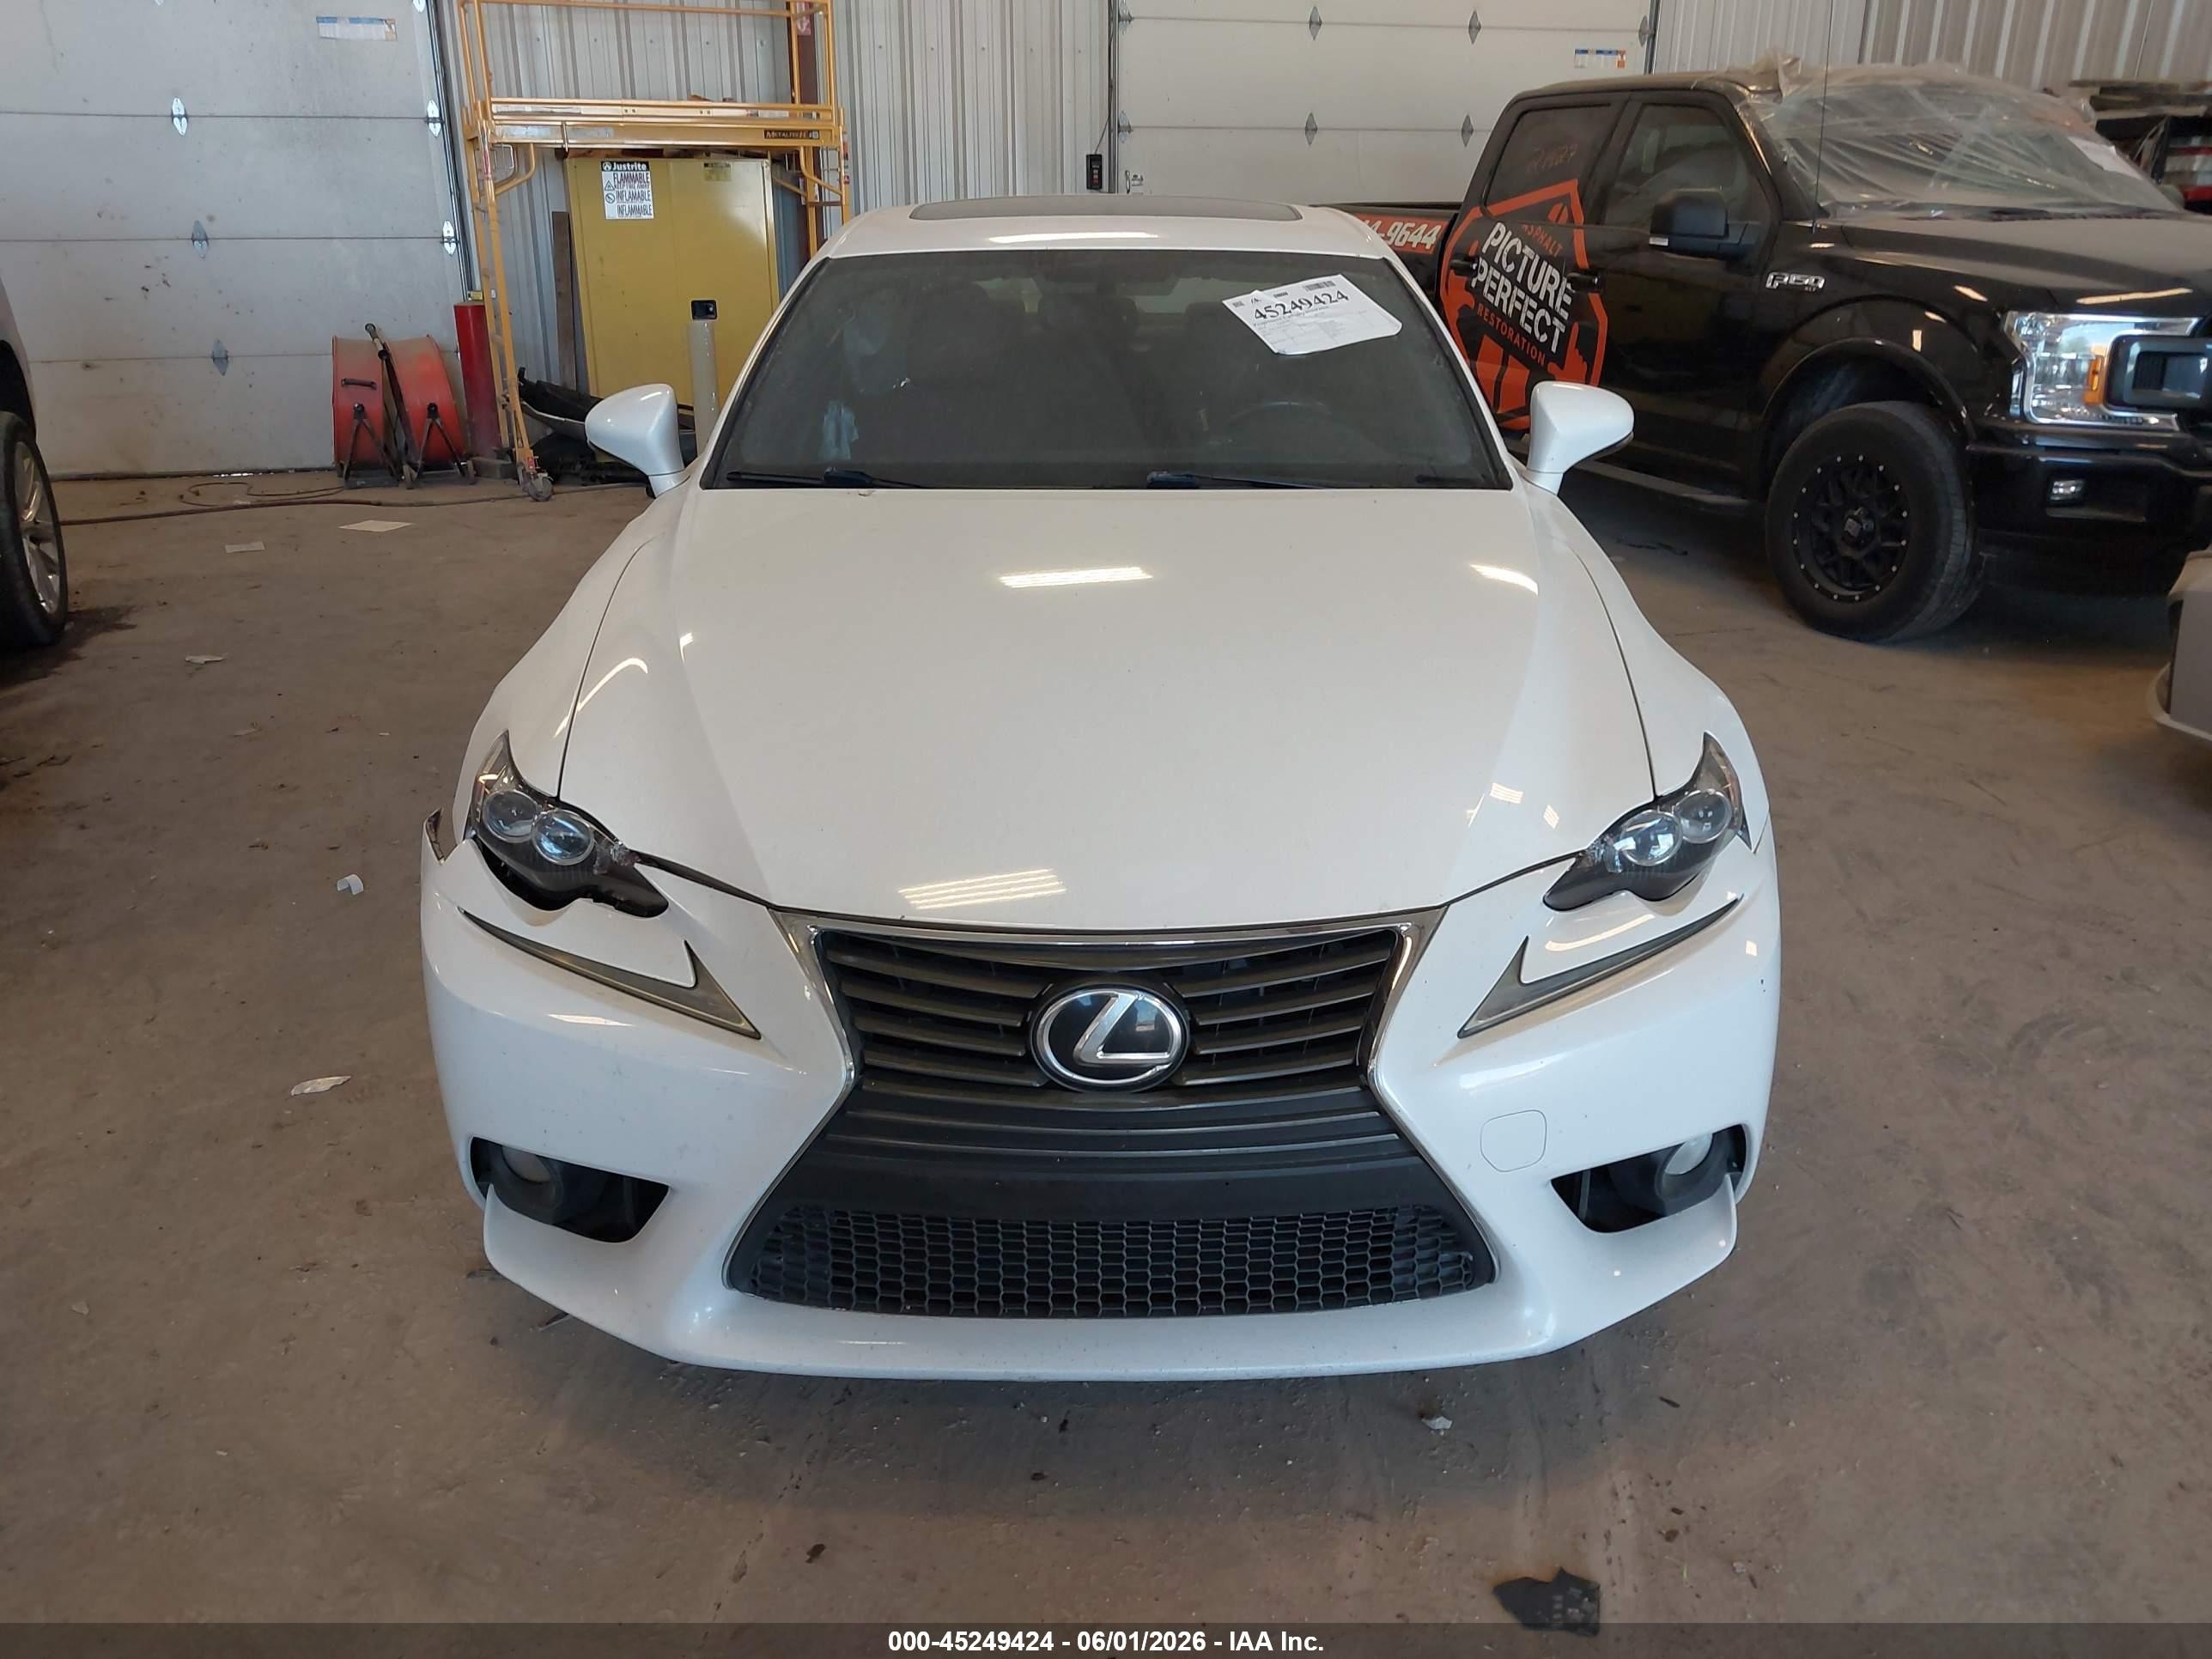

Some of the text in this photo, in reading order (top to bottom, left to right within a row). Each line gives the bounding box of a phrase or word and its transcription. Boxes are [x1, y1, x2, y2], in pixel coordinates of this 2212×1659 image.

[612, 161, 647, 171] Justrite
[613, 172, 650, 184] FLAMMABLE
[1482, 222, 1575, 321] PICTURE
[1255, 289, 1350, 320] 45249424
[1471, 257, 1566, 354] PERFECT
[1476, 303, 1546, 366] RESTORATION
